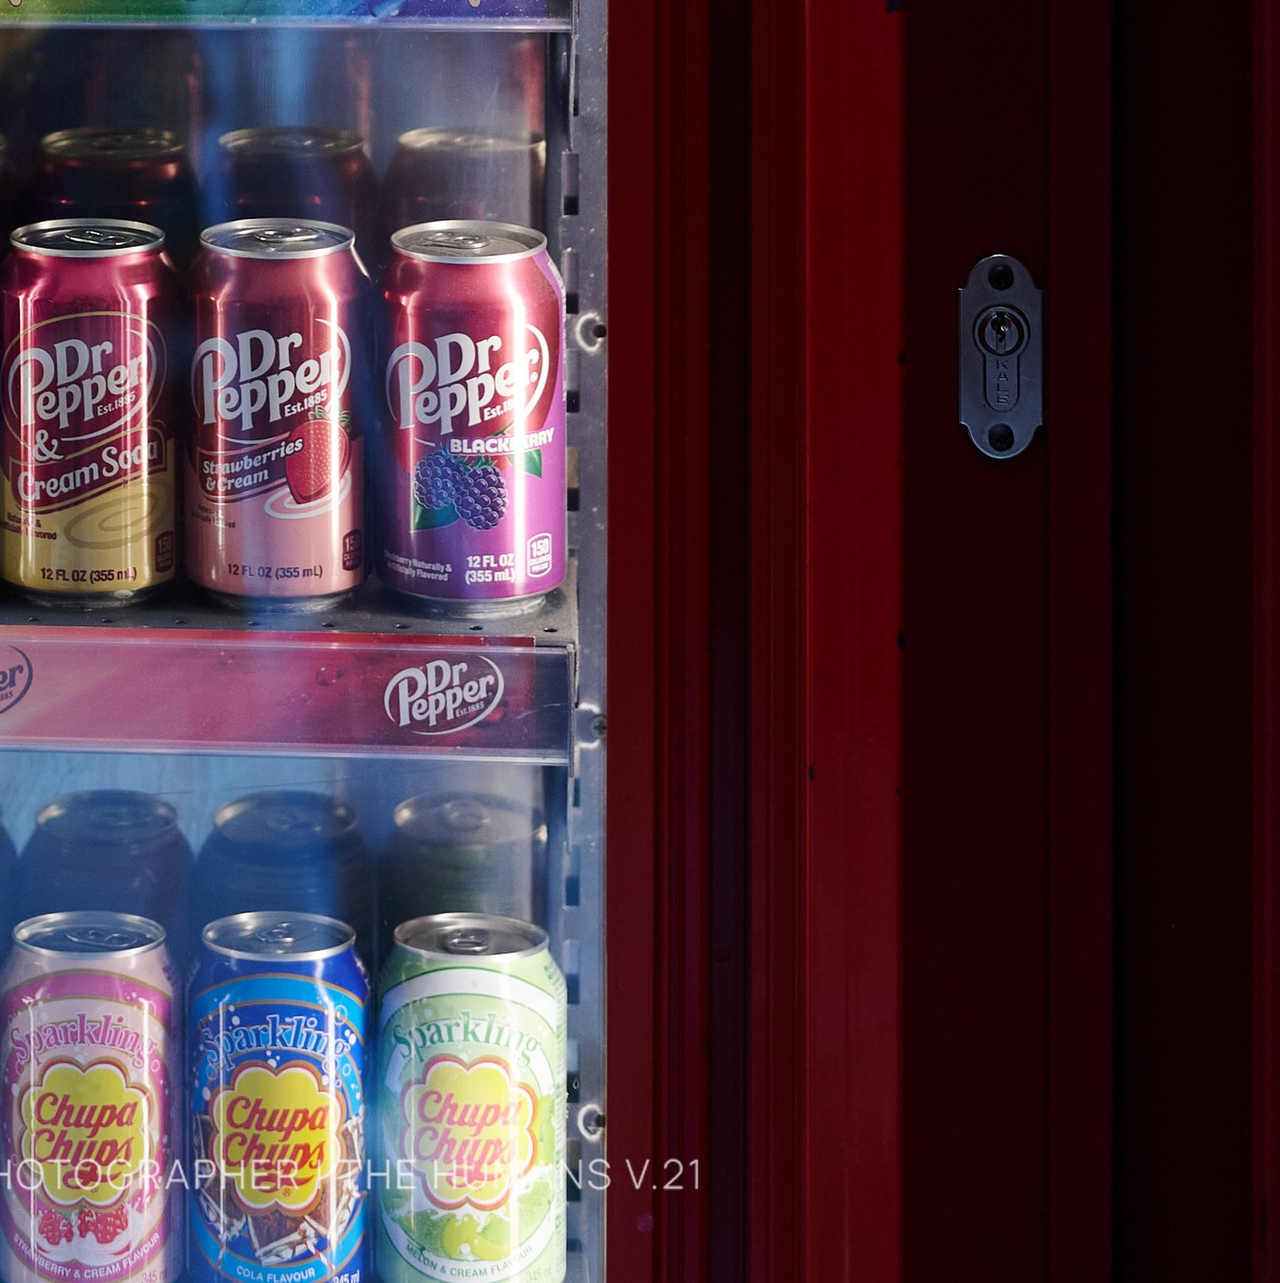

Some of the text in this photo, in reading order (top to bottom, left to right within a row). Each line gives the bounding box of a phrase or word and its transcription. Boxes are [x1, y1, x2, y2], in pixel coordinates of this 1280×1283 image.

[202, 437, 303, 474] Strawberries
[227, 563, 323, 580] 12 FL OZ (355 mL)
[467, 553, 515, 567] 12 FL OZ
[41, 567, 137, 584] 12 FL OZ (355 mL)
[465, 570, 515, 584] (355 mL)
[426, 660, 467, 690] Dr
[385, 667, 494, 726] Pepper
[35, 1093, 138, 1136] Chupa
[226, 1096, 329, 1143] Chupa
[14, 1232, 160, 1279] STRAWBERRY & CREAM FLAVOUR
[237, 1266, 315, 1283] COLA FLAVOUR
